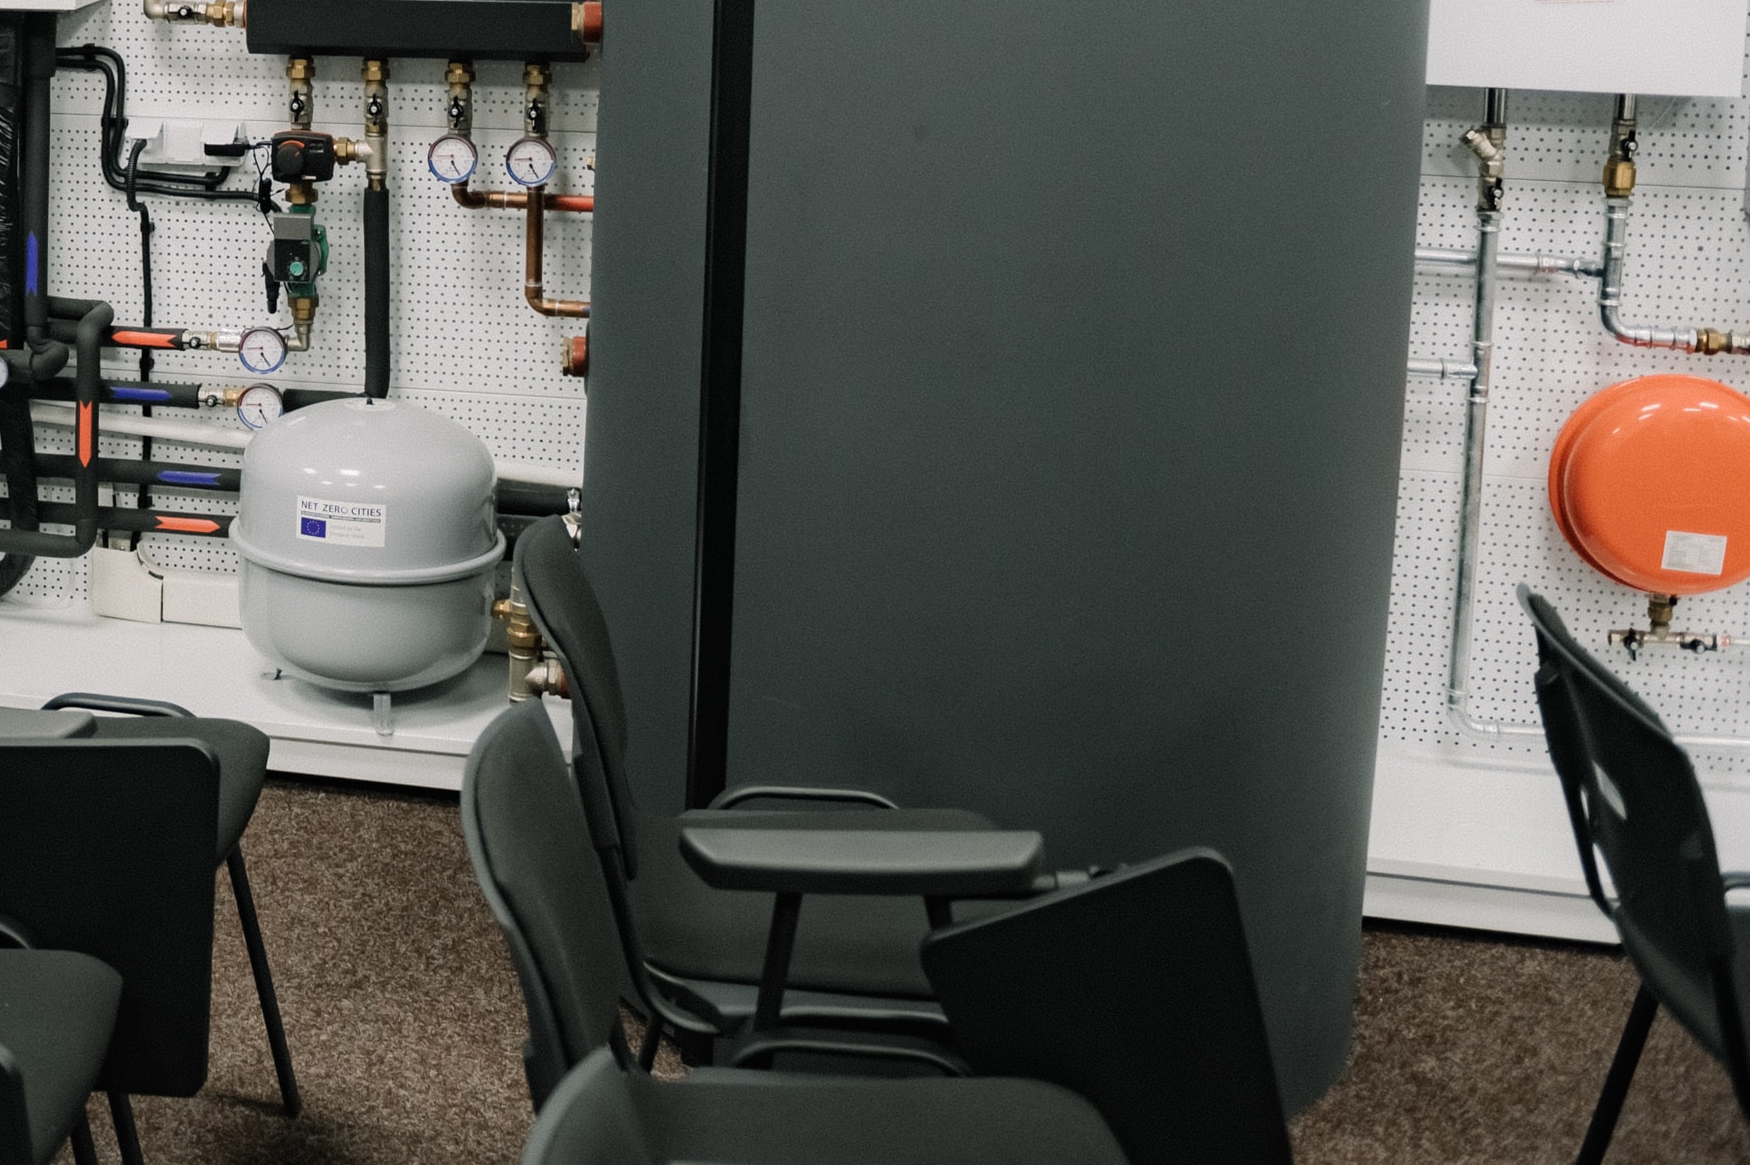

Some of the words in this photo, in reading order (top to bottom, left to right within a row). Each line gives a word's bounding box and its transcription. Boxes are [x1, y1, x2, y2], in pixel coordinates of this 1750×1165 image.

[301, 500, 318, 510] NET
[322, 504, 349, 514] ZERO
[351, 507, 382, 517] CITIES
